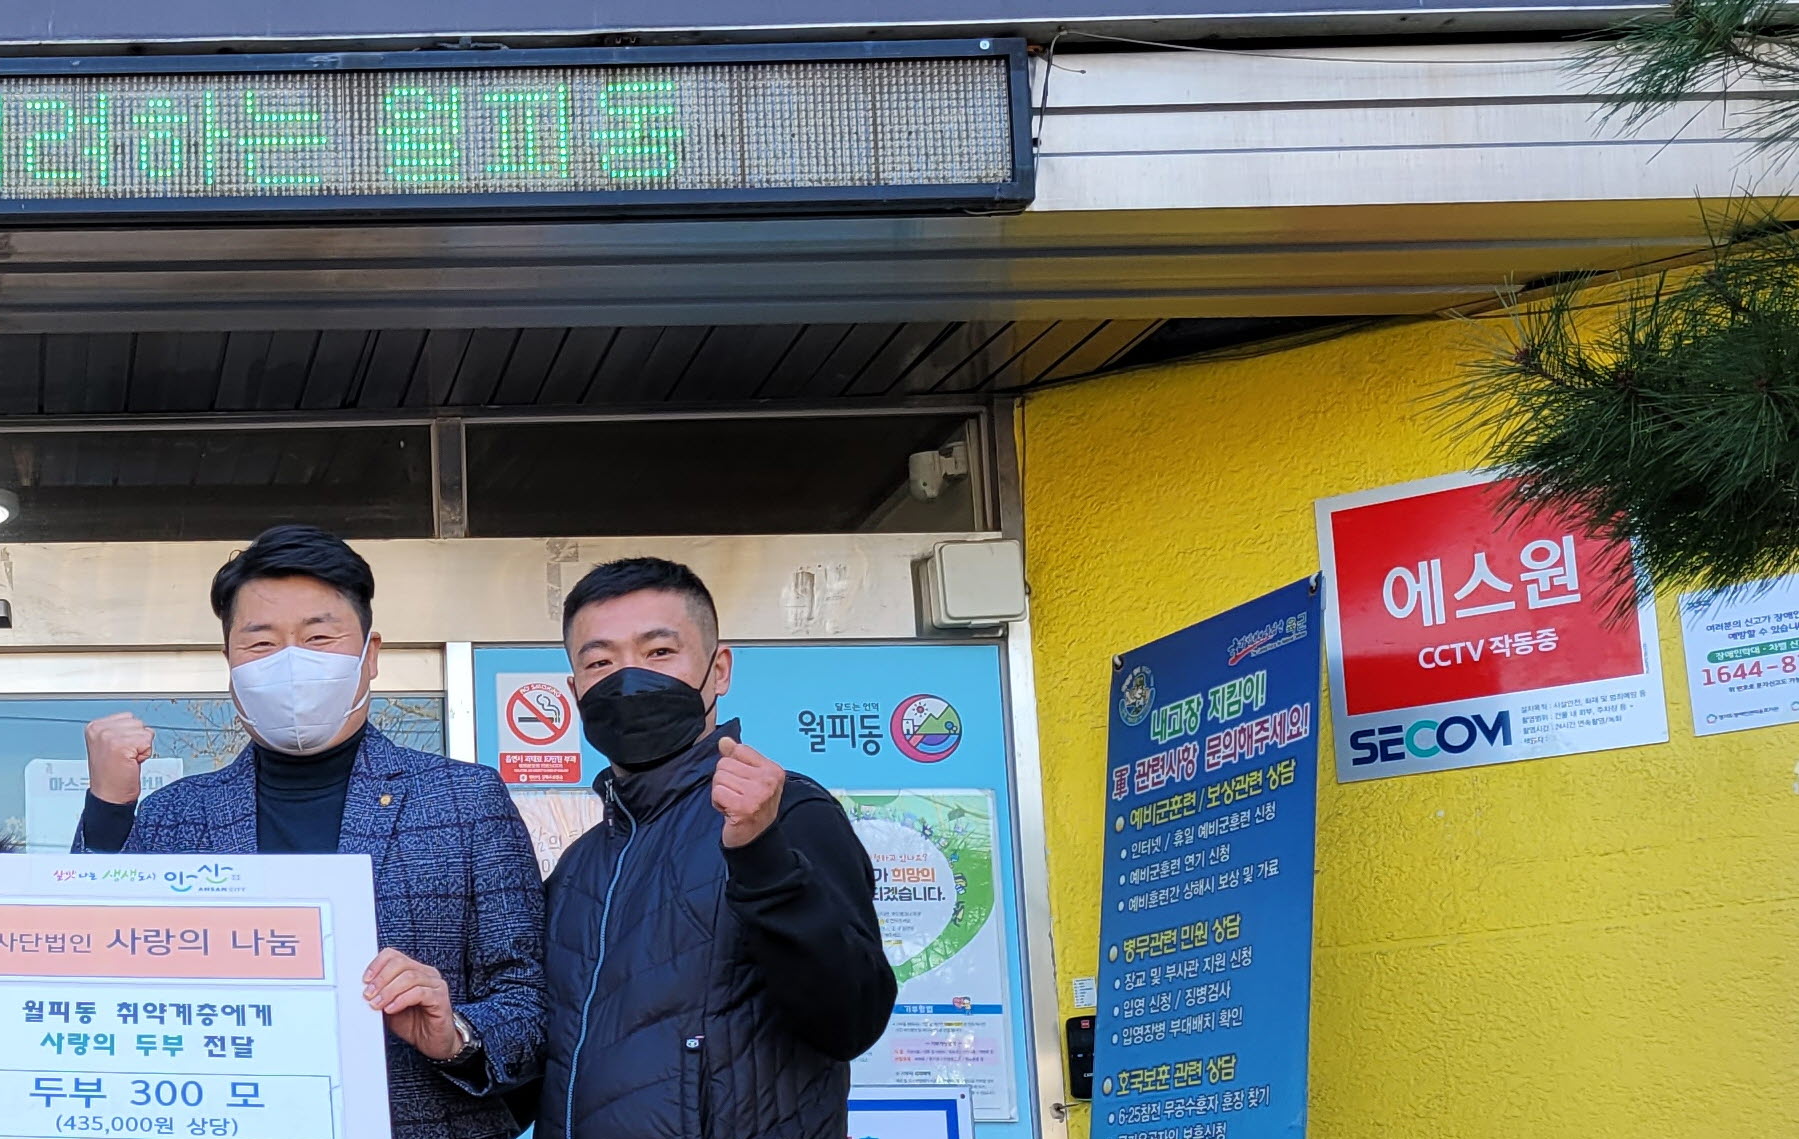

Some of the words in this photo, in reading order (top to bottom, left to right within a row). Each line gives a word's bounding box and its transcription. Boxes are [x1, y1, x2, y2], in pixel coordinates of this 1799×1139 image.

[377, 79, 685, 183] 월피동
[1382, 534, 1581, 628] 에스원
[1745, 614, 1771, 627] 신고가
[1418, 637, 1484, 670] CCTV
[1489, 627, 1560, 659] 작동중
[835, 702, 861, 712] 달드는
[862, 703, 880, 712] 언덕
[1151, 693, 1204, 744] 내고장
[1208, 670, 1267, 723] 지킴이!
[798, 710, 884, 757] 월피동
[1112, 764, 1130, 801] 軍
[1134, 742, 1199, 795] 관련사항
[1205, 702, 1310, 772] 문의해주세요!
[1350, 709, 1513, 767] SECOM
[1130, 790, 1196, 831] 예비군훈련
[1206, 769, 1262, 809] 보상관련
[1266, 759, 1296, 790] 상담
[1131, 835, 1161, 859] 인터넷
[1173, 826, 1195, 847] 휴일
[1198, 809, 1251, 840] 예비군훈련
[1254, 801, 1276, 824] 신청
[892, 867, 935, 882] 희망의
[1128, 886, 1180, 912] 예비훈련간
[1183, 876, 1215, 900] 상해시
[1218, 869, 1240, 891] 보상
[1243, 865, 1253, 883] 및
[1257, 858, 1280, 879] 가료
[1129, 859, 1181, 885] 예비군훈련
[1184, 851, 1205, 872] 연기
[1208, 844, 1230, 866] 신청
[106, 928, 211, 957] 사랑의
[231, 928, 300, 958] 나눔
[1123, 928, 1177, 963] 병무관련
[1180, 921, 1208, 950] 민원
[1212, 912, 1241, 943] 상담
[1124, 971, 1146, 991] 장교
[1150, 967, 1161, 986] 및
[1165, 959, 1199, 983] 부사관
[1203, 953, 1226, 974] 지원
[1230, 946, 1253, 969] 신청
[22, 999, 97, 1025] 월피동
[116, 1001, 274, 1028] 취약계층에게
[1123, 998, 1145, 1019] 입영
[1149, 992, 1172, 1014] 신청
[1185, 980, 1231, 1006] 징병검사
[40, 1031, 116, 1057] 사랑의
[136, 1033, 185, 1058] 두부
[204, 1034, 256, 1059] 전달
[1122, 1020, 1166, 1046] 입영장병
[1169, 1011, 1215, 1037] 부대배치
[1219, 1006, 1243, 1028] 확인
[29, 1075, 108, 1109] 두부
[130, 1079, 203, 1108] 300
[226, 1080, 266, 1109] 모
[1116, 1065, 1171, 1096] 호국보훈
[1174, 1059, 1202, 1089] 관련
[1207, 1054, 1237, 1084] 상담
[55, 1115, 175, 1136] (435,000원
[186, 1115, 239, 1137] 상당)
